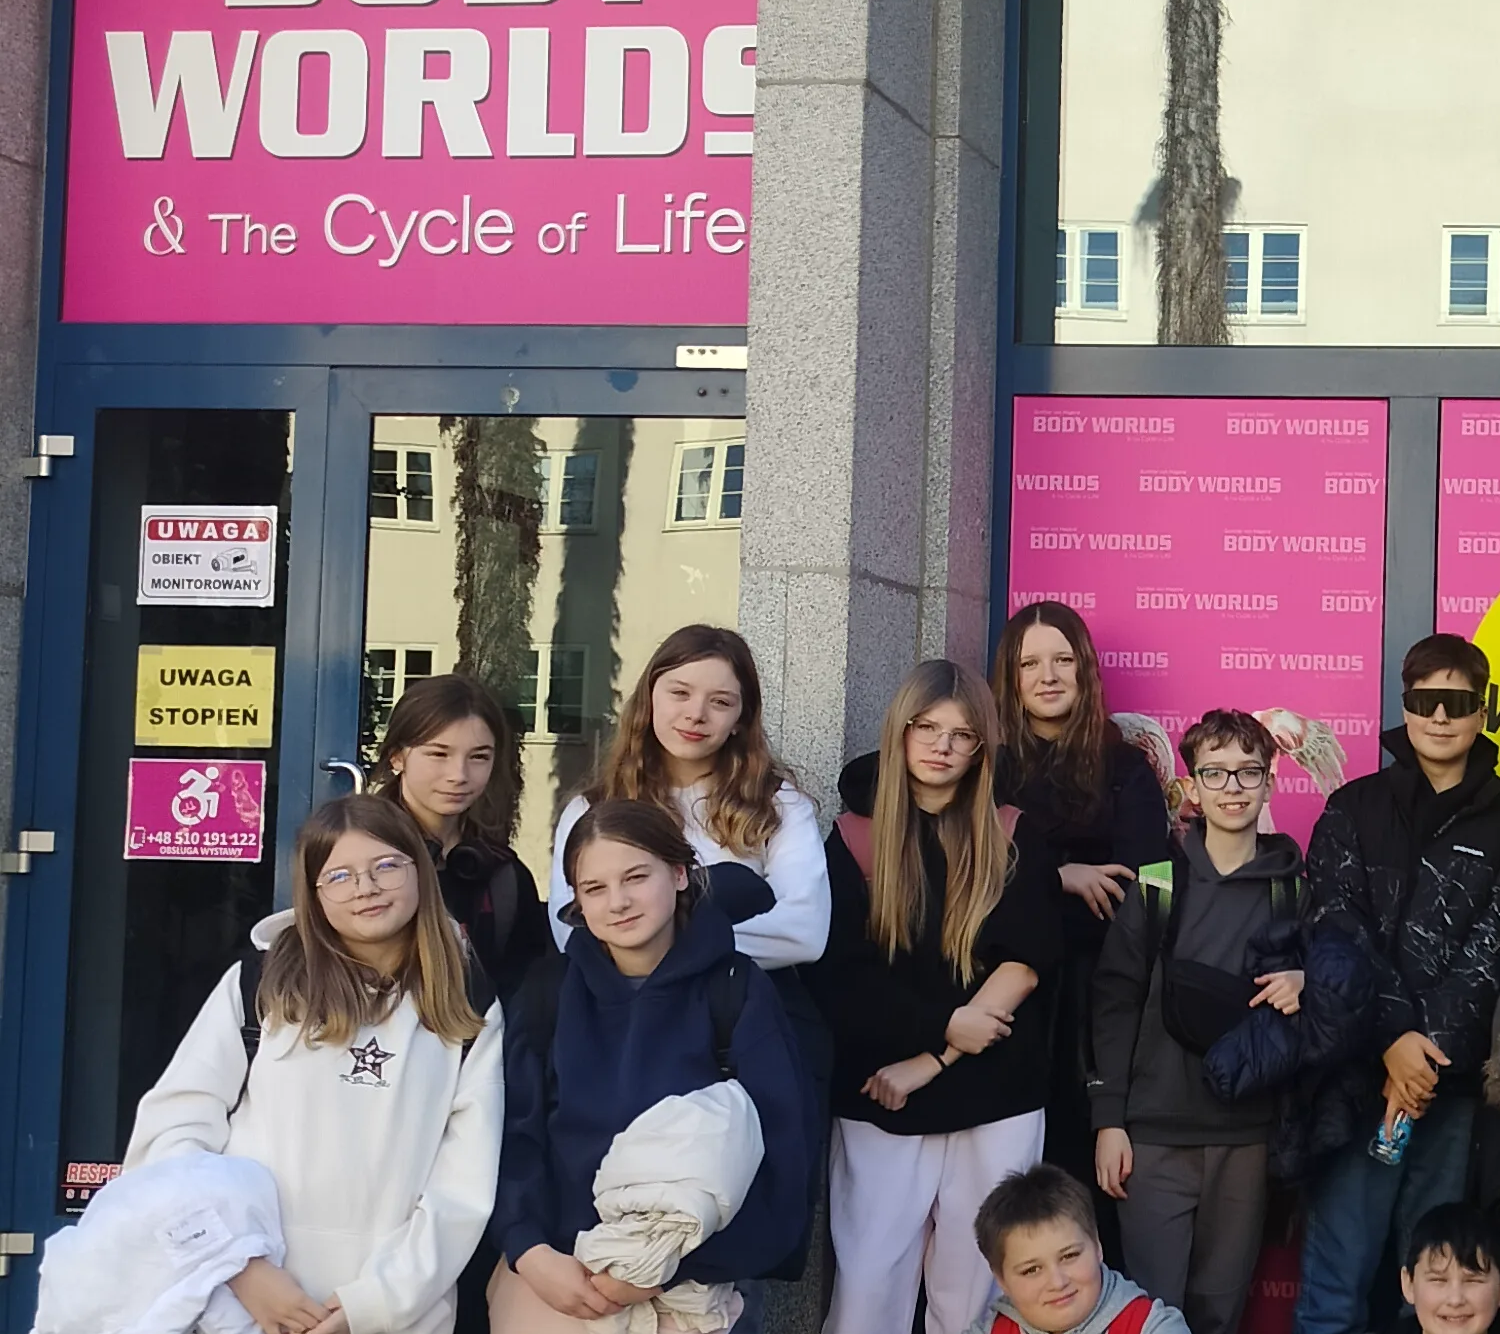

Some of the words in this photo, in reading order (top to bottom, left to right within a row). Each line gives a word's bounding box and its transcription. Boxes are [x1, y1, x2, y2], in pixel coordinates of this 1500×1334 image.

[143, 195, 187, 256] &
[209, 213, 297, 254] The
[323, 193, 515, 267] Cycle
[537, 212, 589, 254] of
[615, 191, 747, 254] Life
[1033, 417, 1088, 433] BODY
[1091, 417, 1175, 434] WORLDS
[1226, 418, 1282, 435] BODY
[1285, 419, 1369, 436] WORLDS
[1015, 474, 1100, 491] WORLDS
[1139, 476, 1194, 492] BODY
[1197, 477, 1281, 493] WORLDS
[1325, 478, 1379, 494] BODY
[157, 520, 261, 541] UWAGA
[1030, 533, 1085, 550] BODY
[1088, 534, 1172, 551] WORLDS
[1224, 536, 1279, 552] BODY
[1282, 536, 1366, 553] WORLDS
[152, 552, 202, 566] OBIEKT
[150, 577, 262, 592] MONITOROWANY
[1136, 593, 1191, 610] BODY
[1194, 594, 1278, 611] WORLDS
[1321, 595, 1377, 612] BODY
[1221, 653, 1276, 670] BODY
[1279, 654, 1363, 672] WORLDS
[159, 669, 253, 688] UWAGA
[147, 701, 260, 728] STOPIEŃ
[146, 831, 171, 845] +48
[174, 832, 200, 845] 510
[203, 832, 226, 845] 191
[230, 833, 257, 846] 122
[159, 846, 199, 855] OBSŁUGA
[200, 847, 243, 856] WYSTAWY
[67, 1163, 124, 1184] RESPE
